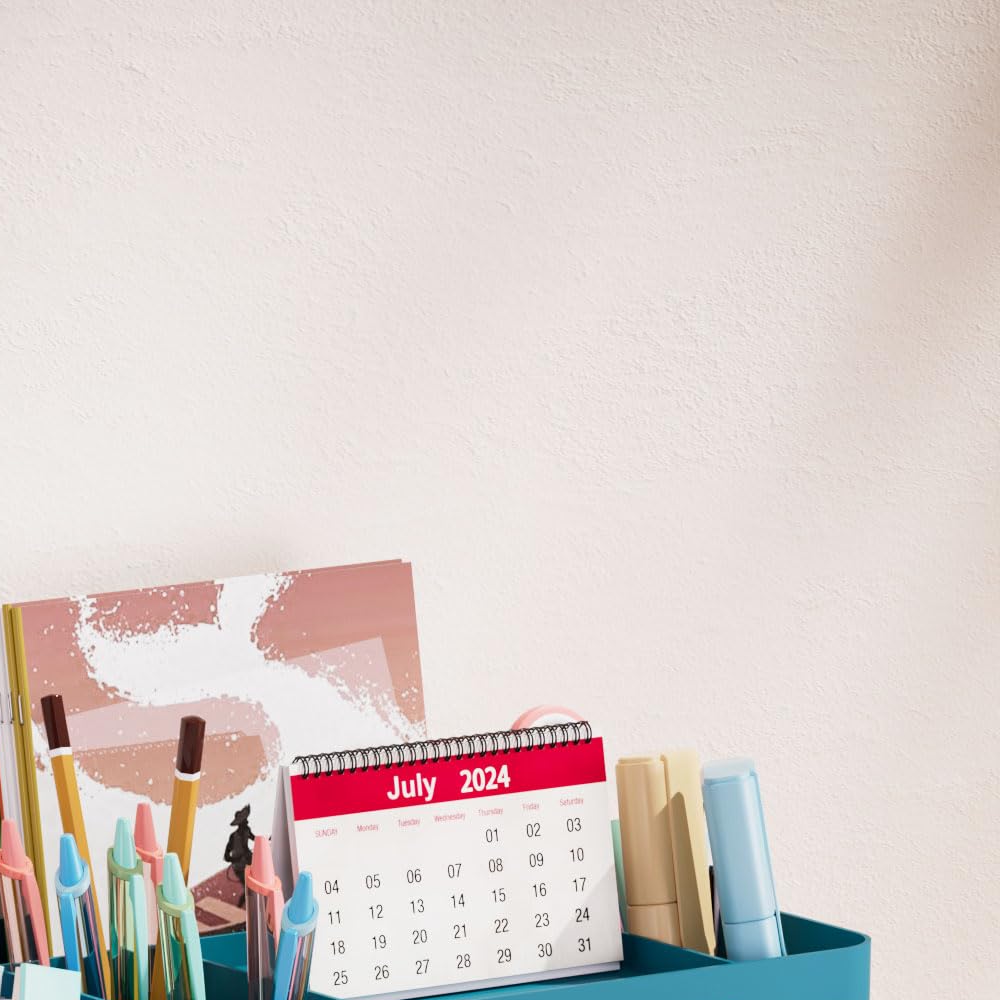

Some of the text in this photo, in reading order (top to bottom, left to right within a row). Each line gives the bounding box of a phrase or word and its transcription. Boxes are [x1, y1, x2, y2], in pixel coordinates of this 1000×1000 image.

[387, 764, 511, 802] July 2024
[357, 823, 379, 833] Monday
[398, 817, 420, 828] Tuesday
[478, 806, 503, 817] Thursday
[522, 801, 540, 811] Friday
[559, 797, 584, 807] Saturday
[486, 818, 581, 842] 01 02 03
[325, 848, 584, 894] 04 05 06 07 08 09 10
[328, 877, 586, 924] 11 12 13 14 15 16 17
[331, 907, 590, 955] 18 19 20 21 22 23 24
[333, 938, 591, 985] 25 26 27 28 29 30 31
